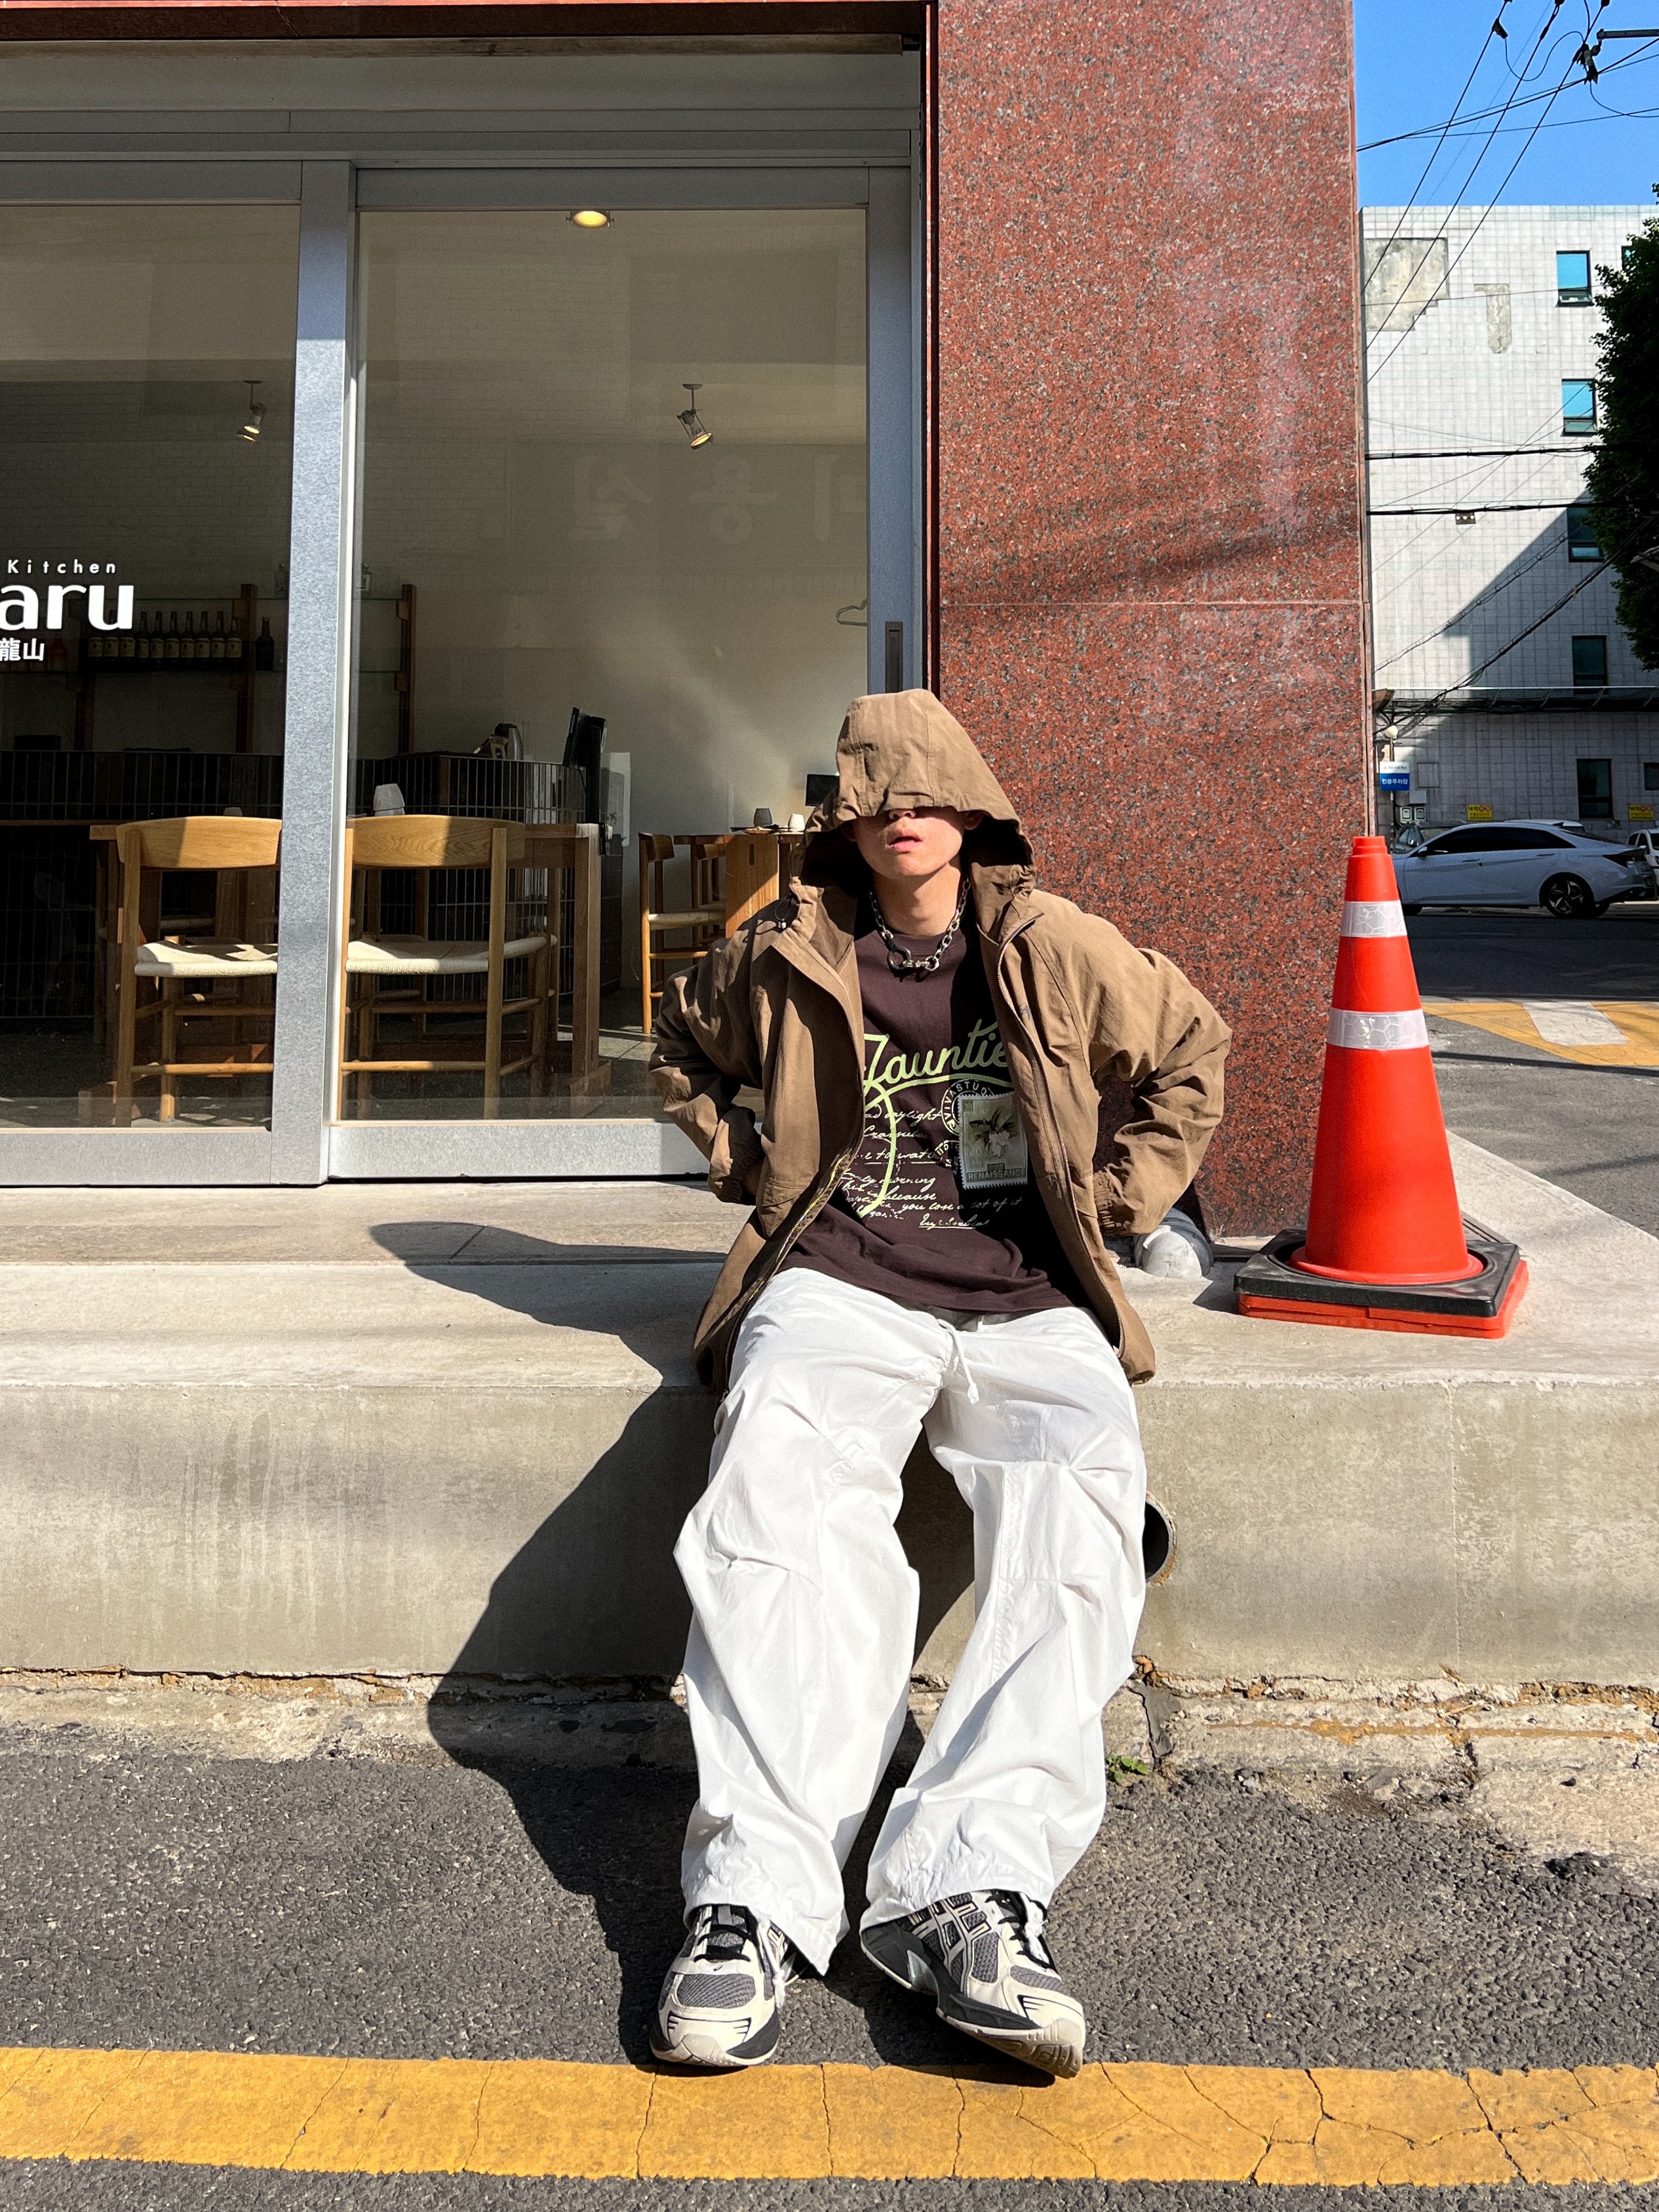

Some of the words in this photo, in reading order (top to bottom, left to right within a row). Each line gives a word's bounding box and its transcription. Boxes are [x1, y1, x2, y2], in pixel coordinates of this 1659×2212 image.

[7, 559, 116, 574] Kitchen
[967, 1168, 1026, 1181] RENAISSANCE
[895, 1203, 926, 1214] you
